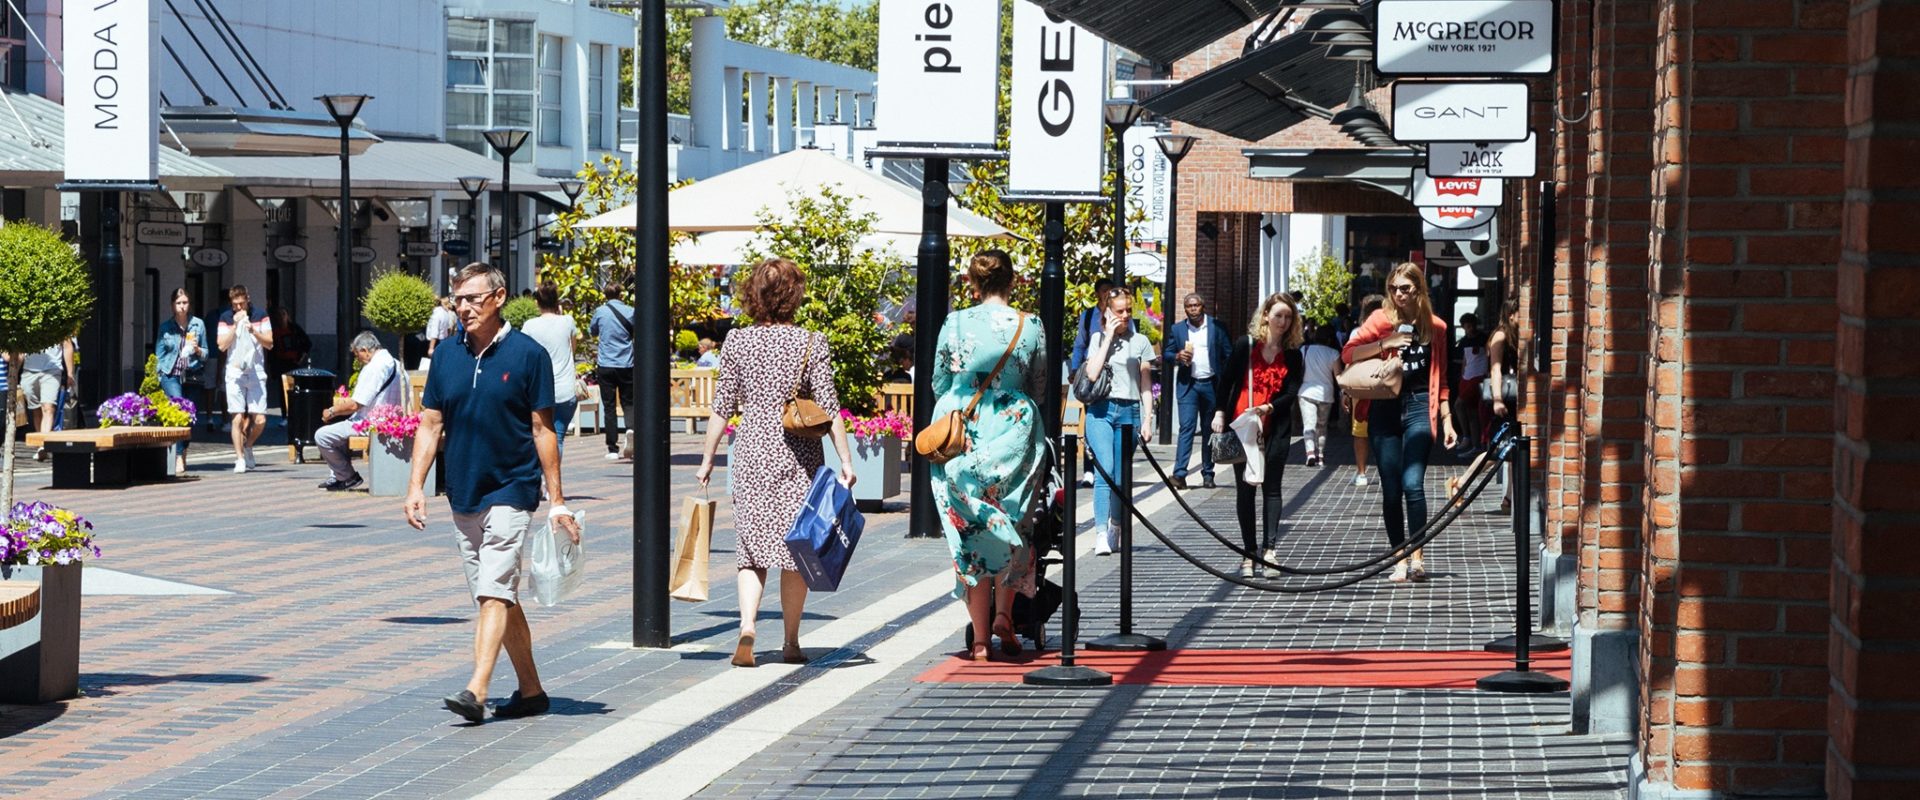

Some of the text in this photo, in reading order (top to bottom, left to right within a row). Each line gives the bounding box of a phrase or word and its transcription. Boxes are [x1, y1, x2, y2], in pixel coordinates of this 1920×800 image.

[915, 2, 961, 73] pie
[1393, 20, 1534, 41] McGREGOR
[1427, 44, 1496, 52] NEW YORK 1921
[94, 23, 118, 129] MODA
[1414, 106, 1508, 119] GANT
[1460, 151, 1503, 167] JAQK
[1132, 144, 1145, 216] UNCOO
[1153, 196, 1164, 221] ZADIG
[141, 227, 164, 236] Calvin
